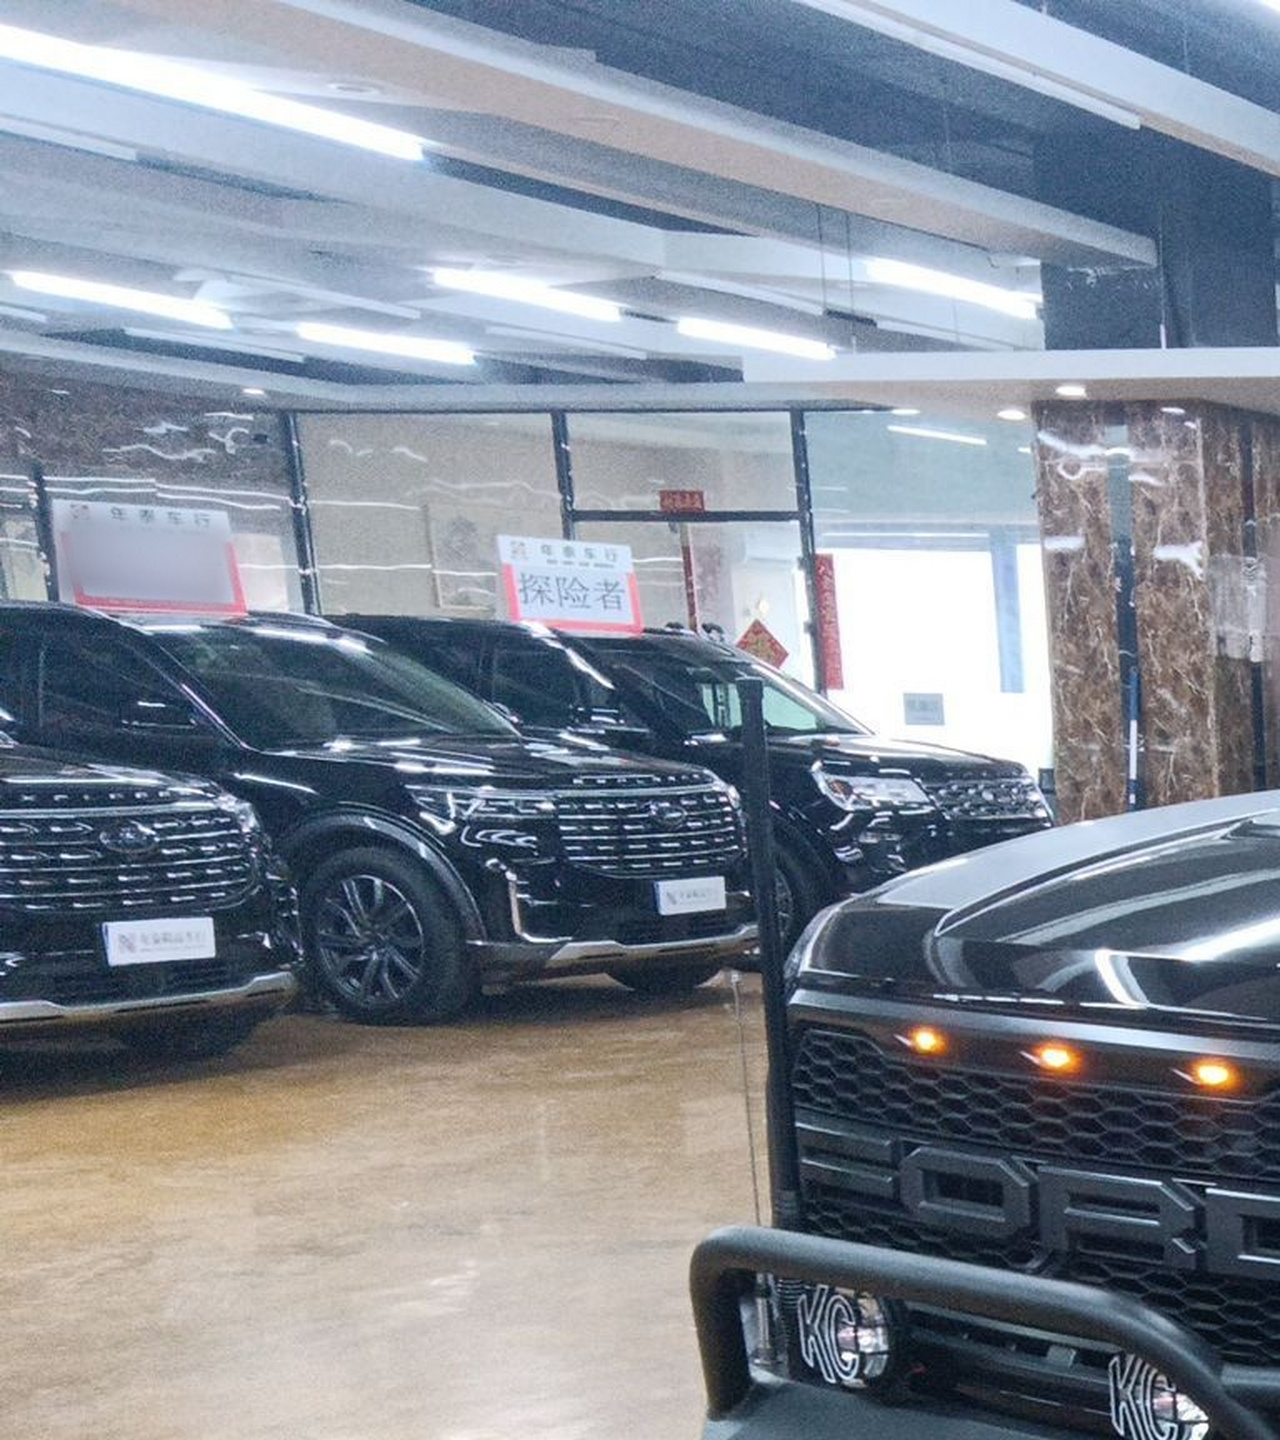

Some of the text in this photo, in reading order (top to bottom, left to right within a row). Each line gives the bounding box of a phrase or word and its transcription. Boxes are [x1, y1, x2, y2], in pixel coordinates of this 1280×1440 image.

[519, 572, 625, 610] 探险者
[798, 1284, 860, 1384] KC
